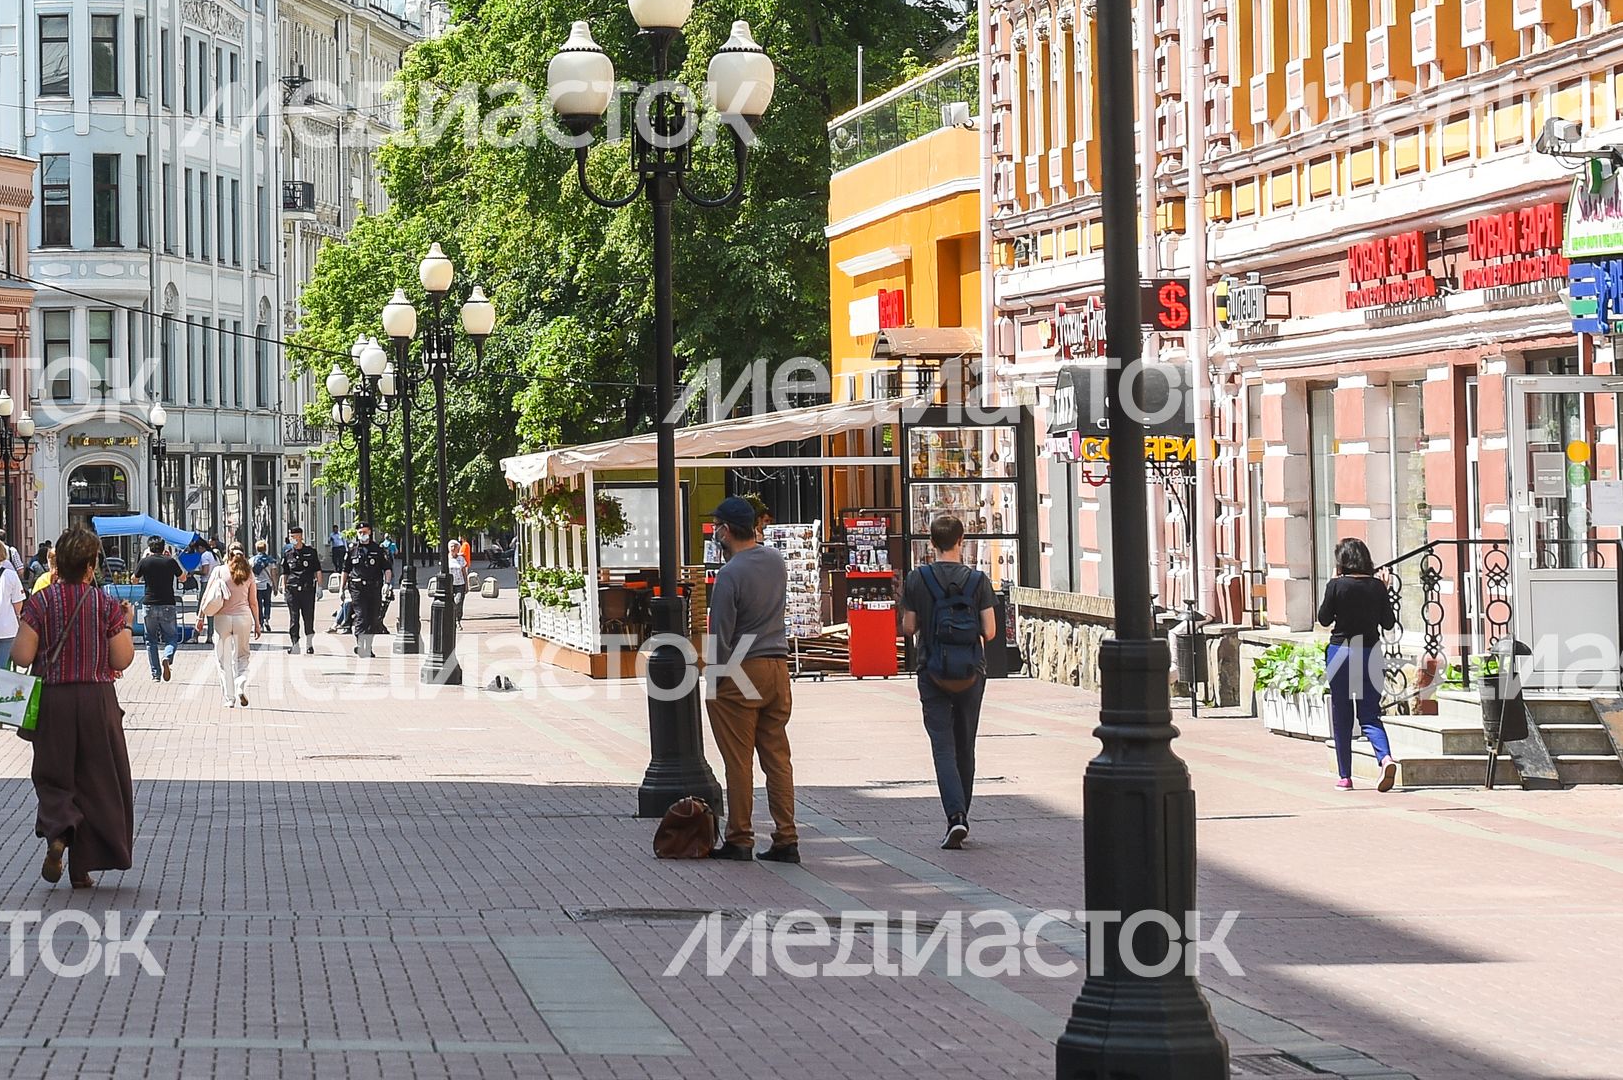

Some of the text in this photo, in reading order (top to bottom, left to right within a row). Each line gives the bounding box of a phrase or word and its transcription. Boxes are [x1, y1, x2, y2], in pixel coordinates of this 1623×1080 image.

[1348, 230, 1423, 283] НОВАЯ ЗАРЯ
[1468, 211, 1517, 261] НОВАЯ
[1519, 203, 1560, 253] ЗАРЯ
